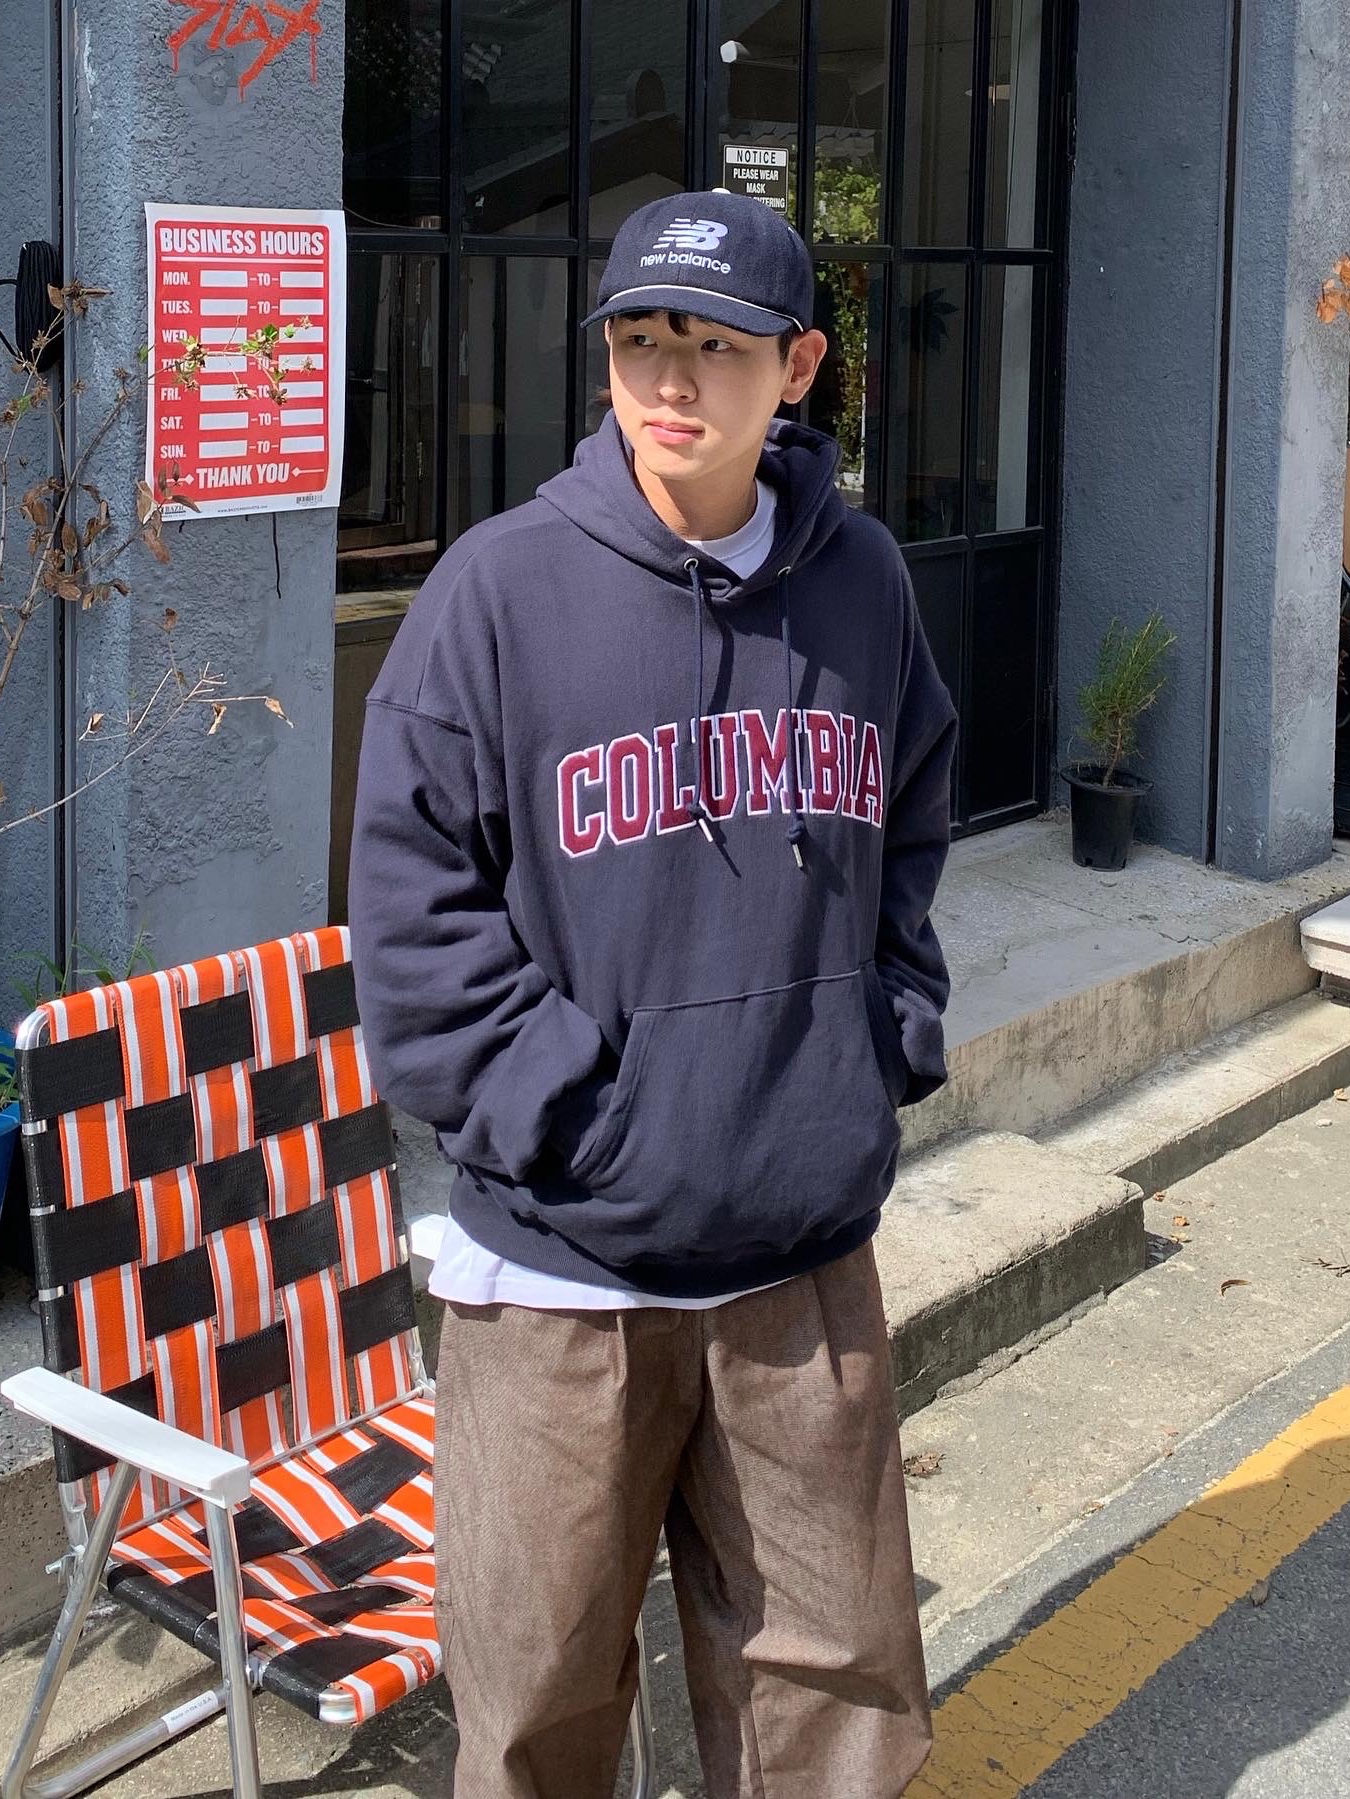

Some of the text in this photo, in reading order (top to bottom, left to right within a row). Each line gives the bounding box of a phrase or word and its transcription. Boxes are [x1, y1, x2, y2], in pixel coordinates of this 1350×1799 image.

[736, 149, 776, 164] NOTICE
[733, 168, 779, 181] PLEASE WEAR
[746, 182, 766, 194] MASK
[753, 196, 785, 208] TERING
[159, 227, 324, 256] BUSINESS HOURS
[640, 251, 731, 274] new balance
[163, 271, 191, 286] MON.
[162, 301, 193, 315] TUES.
[162, 329, 188, 344] WED
[160, 387, 181, 401] FRI.
[160, 416, 184, 430] SAT.
[160, 444, 186, 459] SUN.
[196, 463, 290, 489] THANK YOU
[557, 708, 884, 859] COLUMBIA
